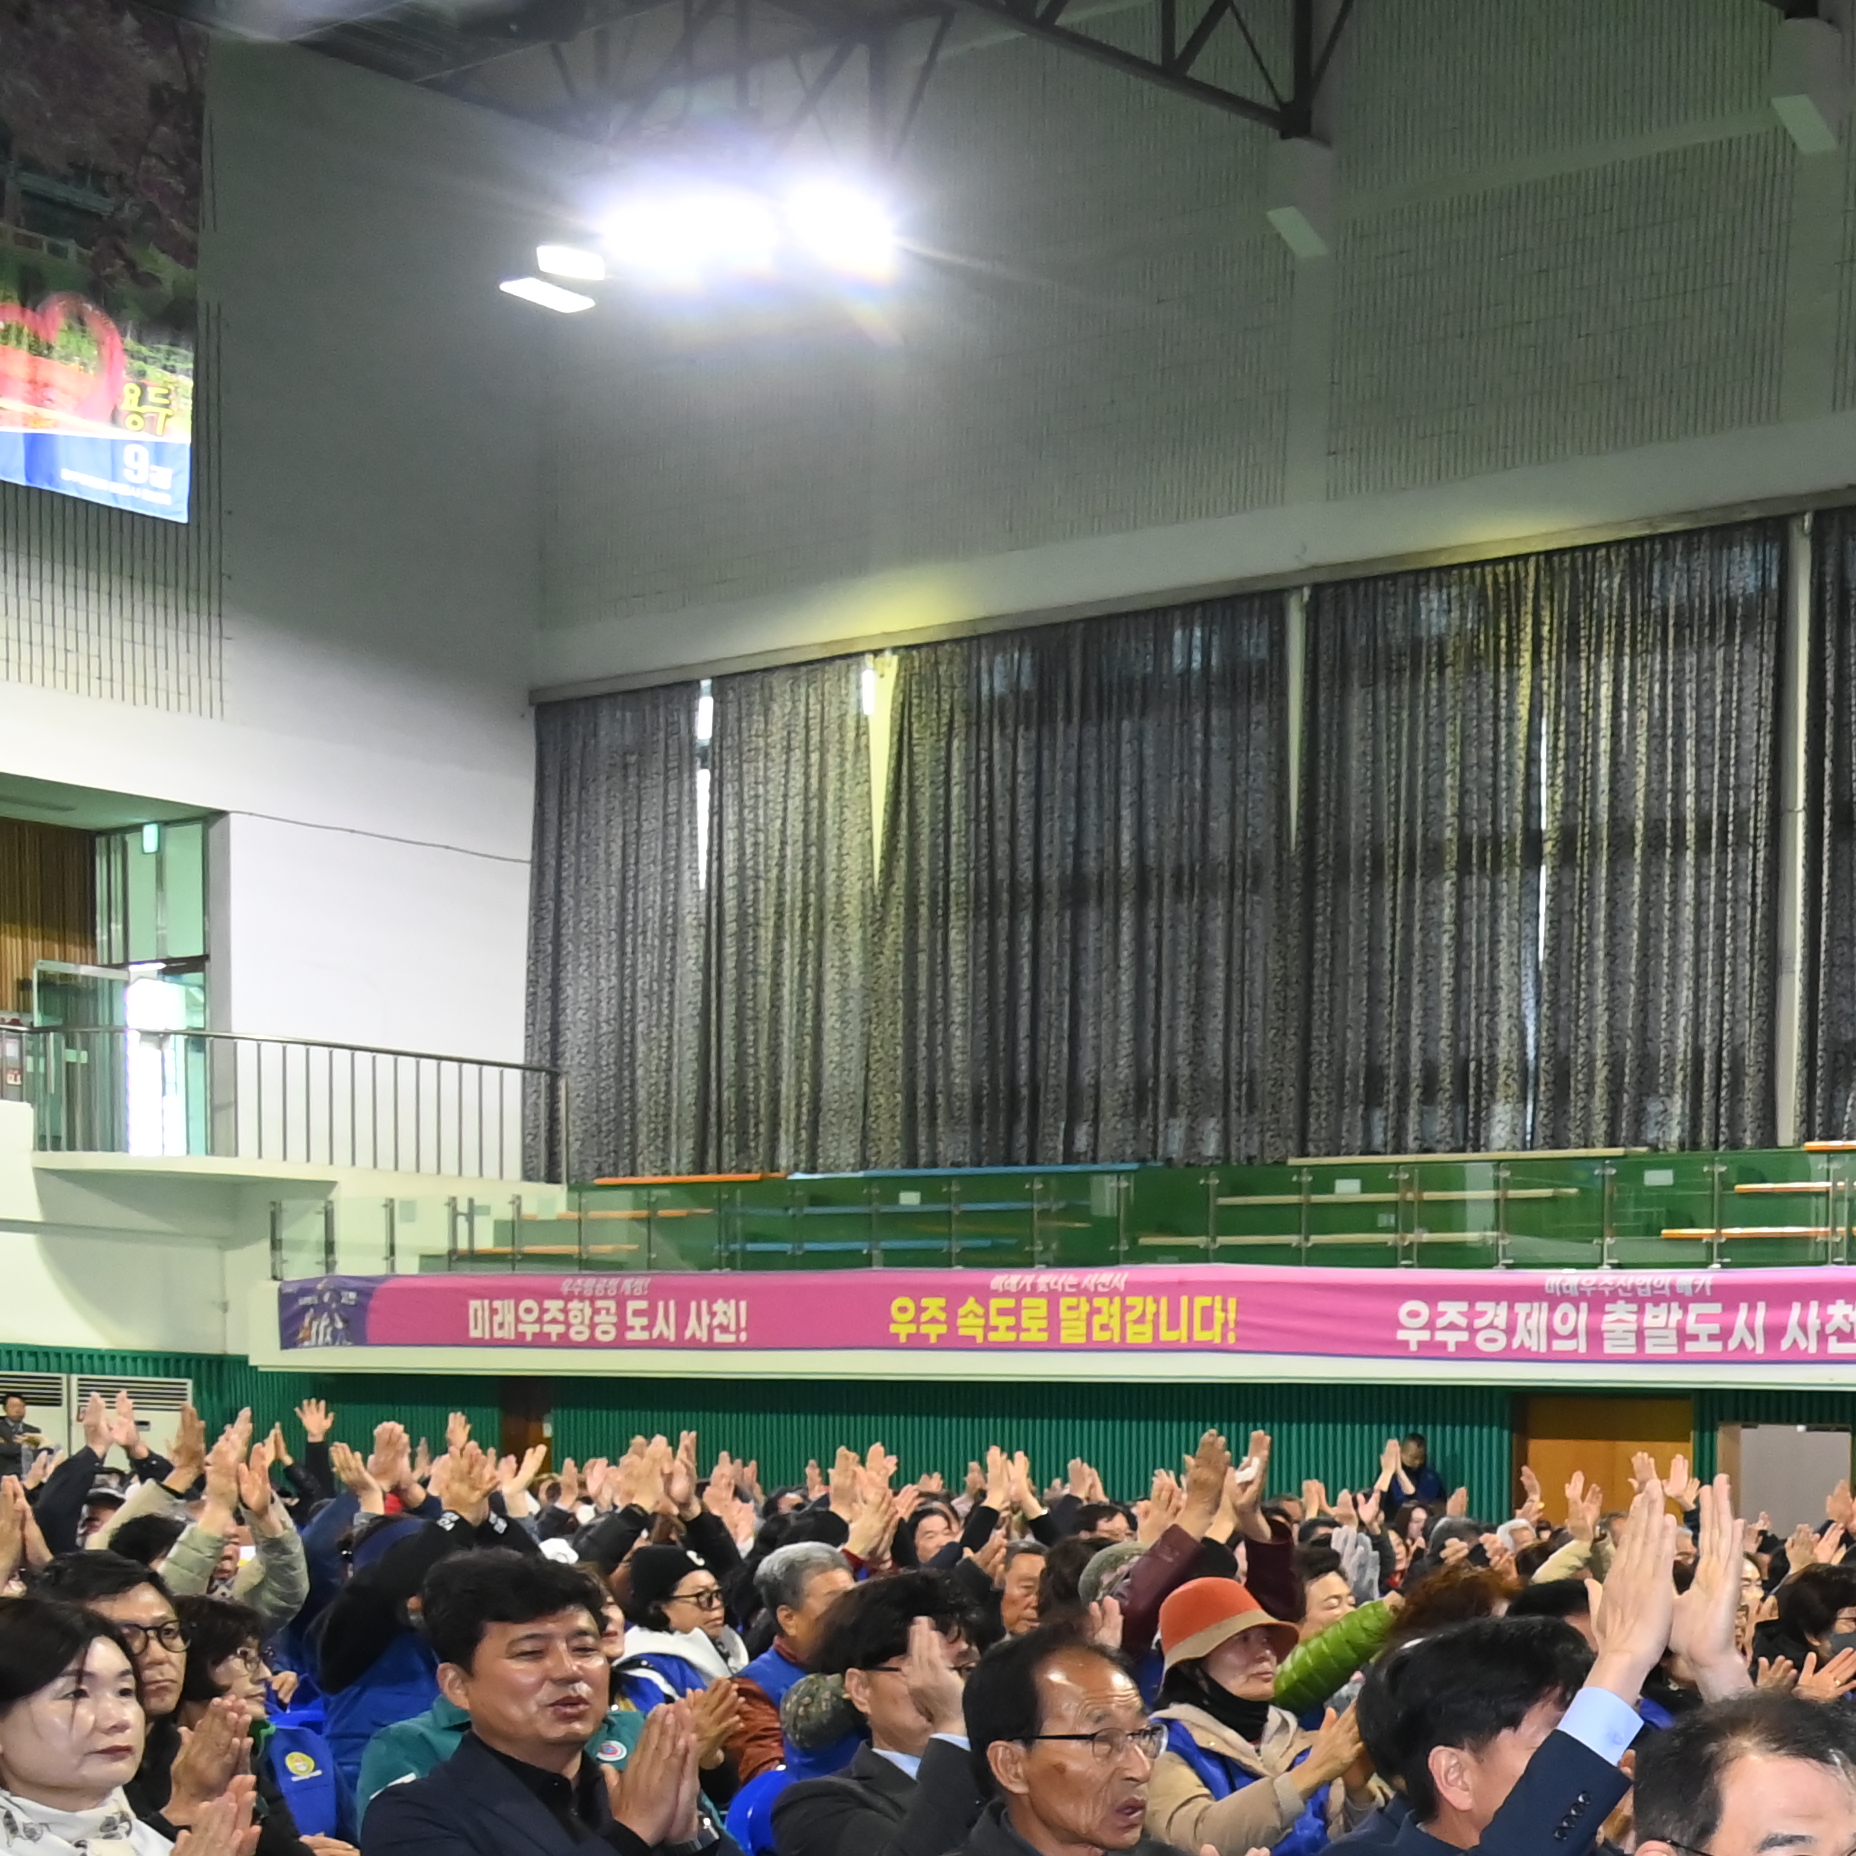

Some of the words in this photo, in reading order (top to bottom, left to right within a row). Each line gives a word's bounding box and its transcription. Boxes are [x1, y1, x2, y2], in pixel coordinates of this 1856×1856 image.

[468, 1299, 618, 1341] 미래우주항공
[625, 1299, 676, 1342] 도시
[684, 1299, 748, 1343] 사천!
[889, 1296, 947, 1343] 우주
[956, 1296, 1048, 1343] 속도로
[1059, 1295, 1237, 1344] 달려갑니다!
[1396, 1299, 1588, 1353] 우주경제의
[1601, 1300, 1765, 1354] 출발도시
